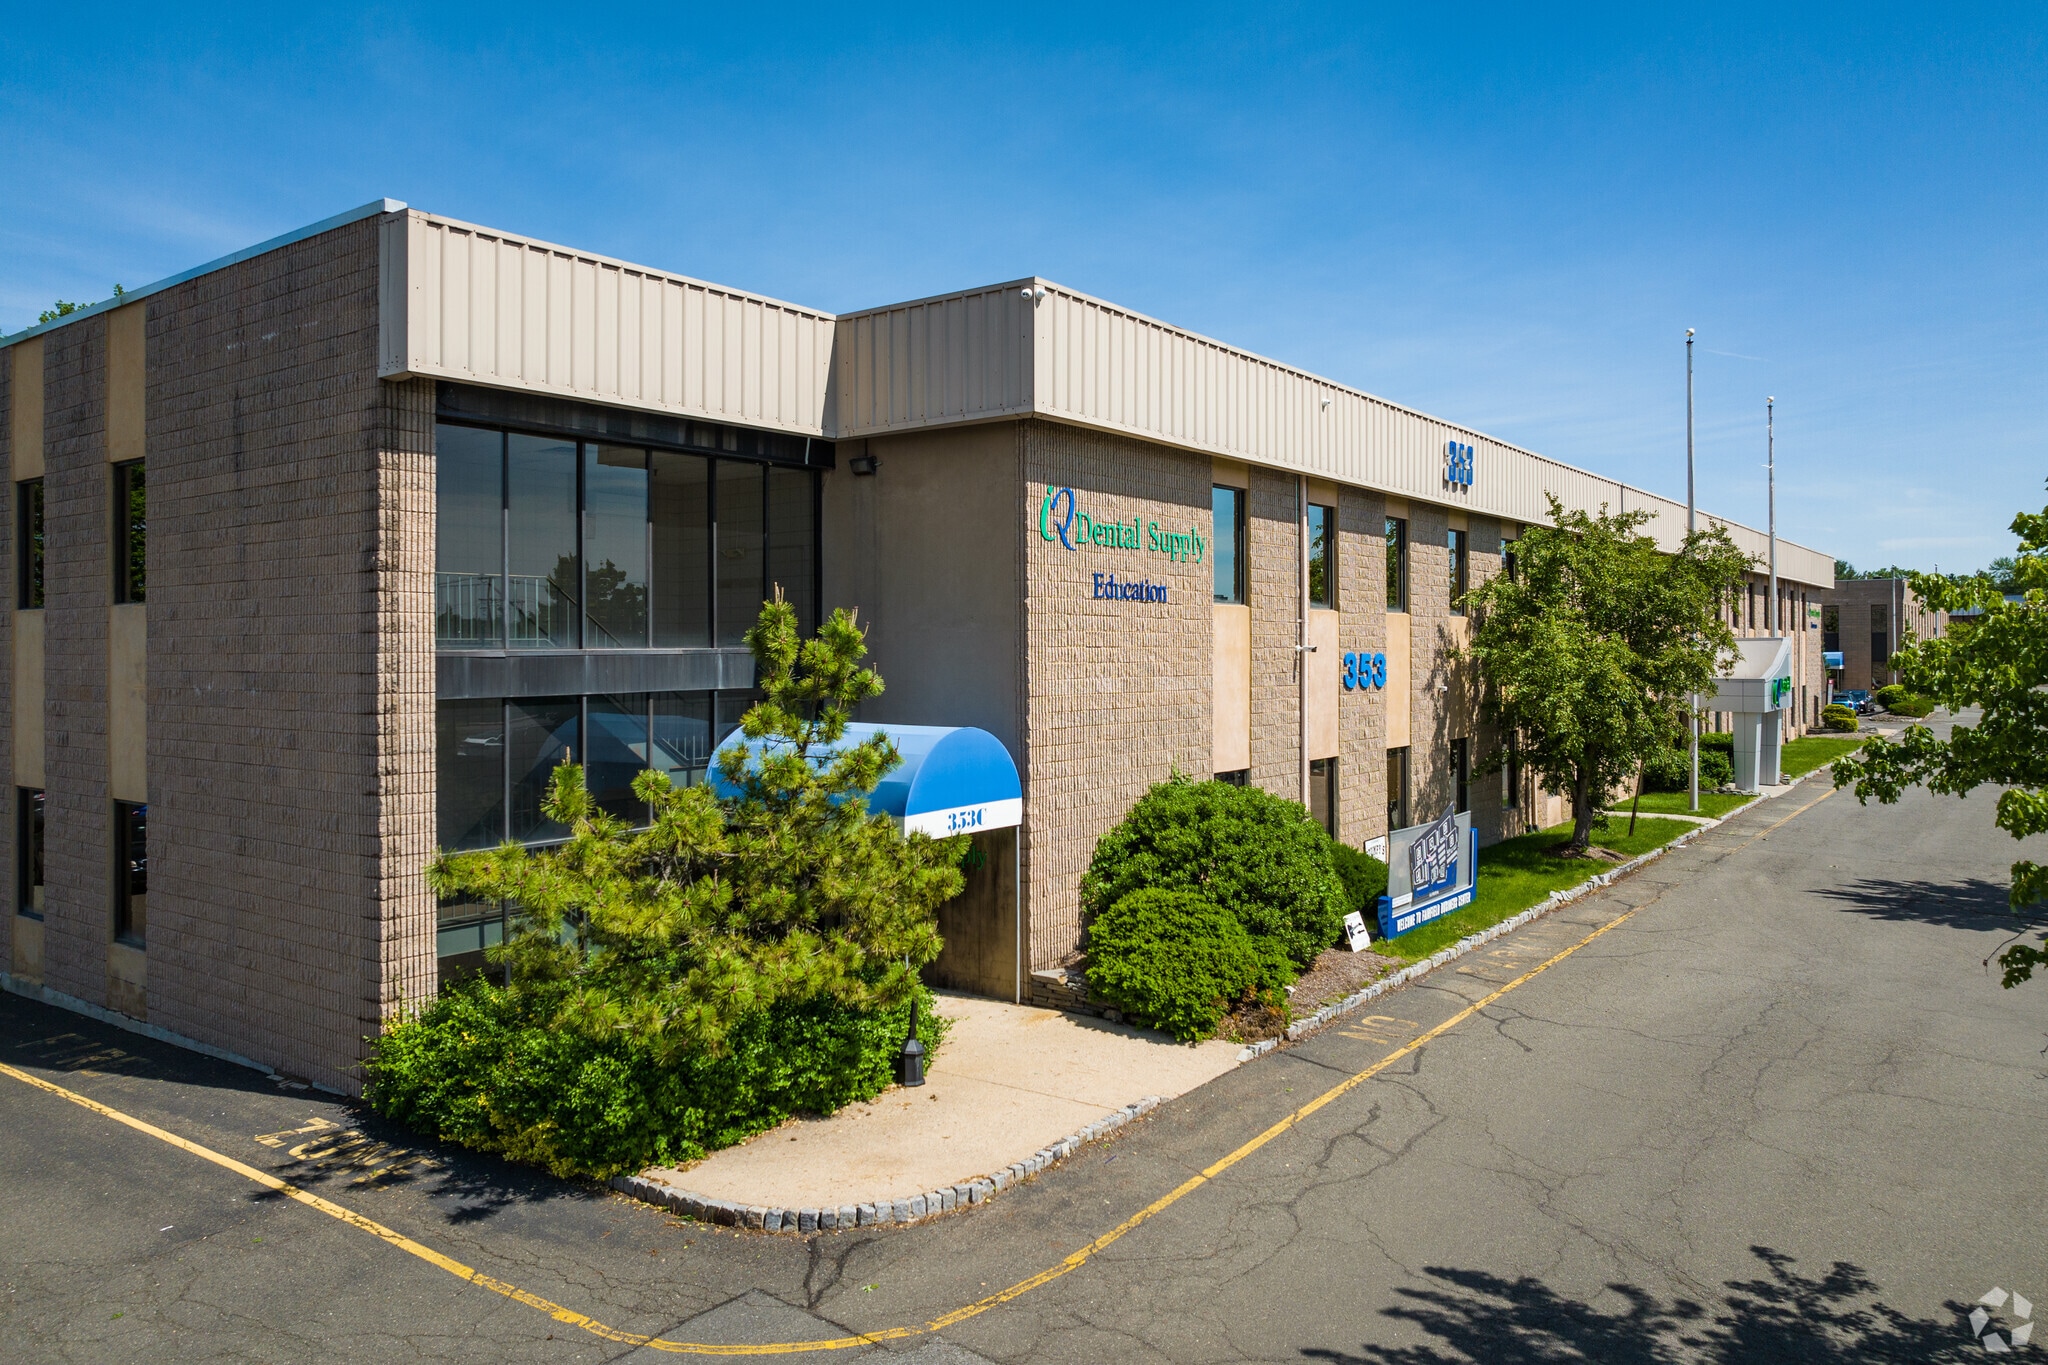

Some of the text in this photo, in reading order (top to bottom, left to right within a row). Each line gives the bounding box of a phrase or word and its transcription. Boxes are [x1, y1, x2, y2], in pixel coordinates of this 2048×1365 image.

[1447, 440, 1474, 486] 353
[1076, 511, 1142, 550] Dental
[1149, 521, 1207, 564] Supply
[1093, 571, 1168, 604] Education
[1343, 651, 1387, 691] 353
[947, 807, 988, 831] 353C
[961, 844, 987, 872] ply
[1338, 1015, 1418, 1045] NO
[254, 1116, 446, 1192] ZONE
